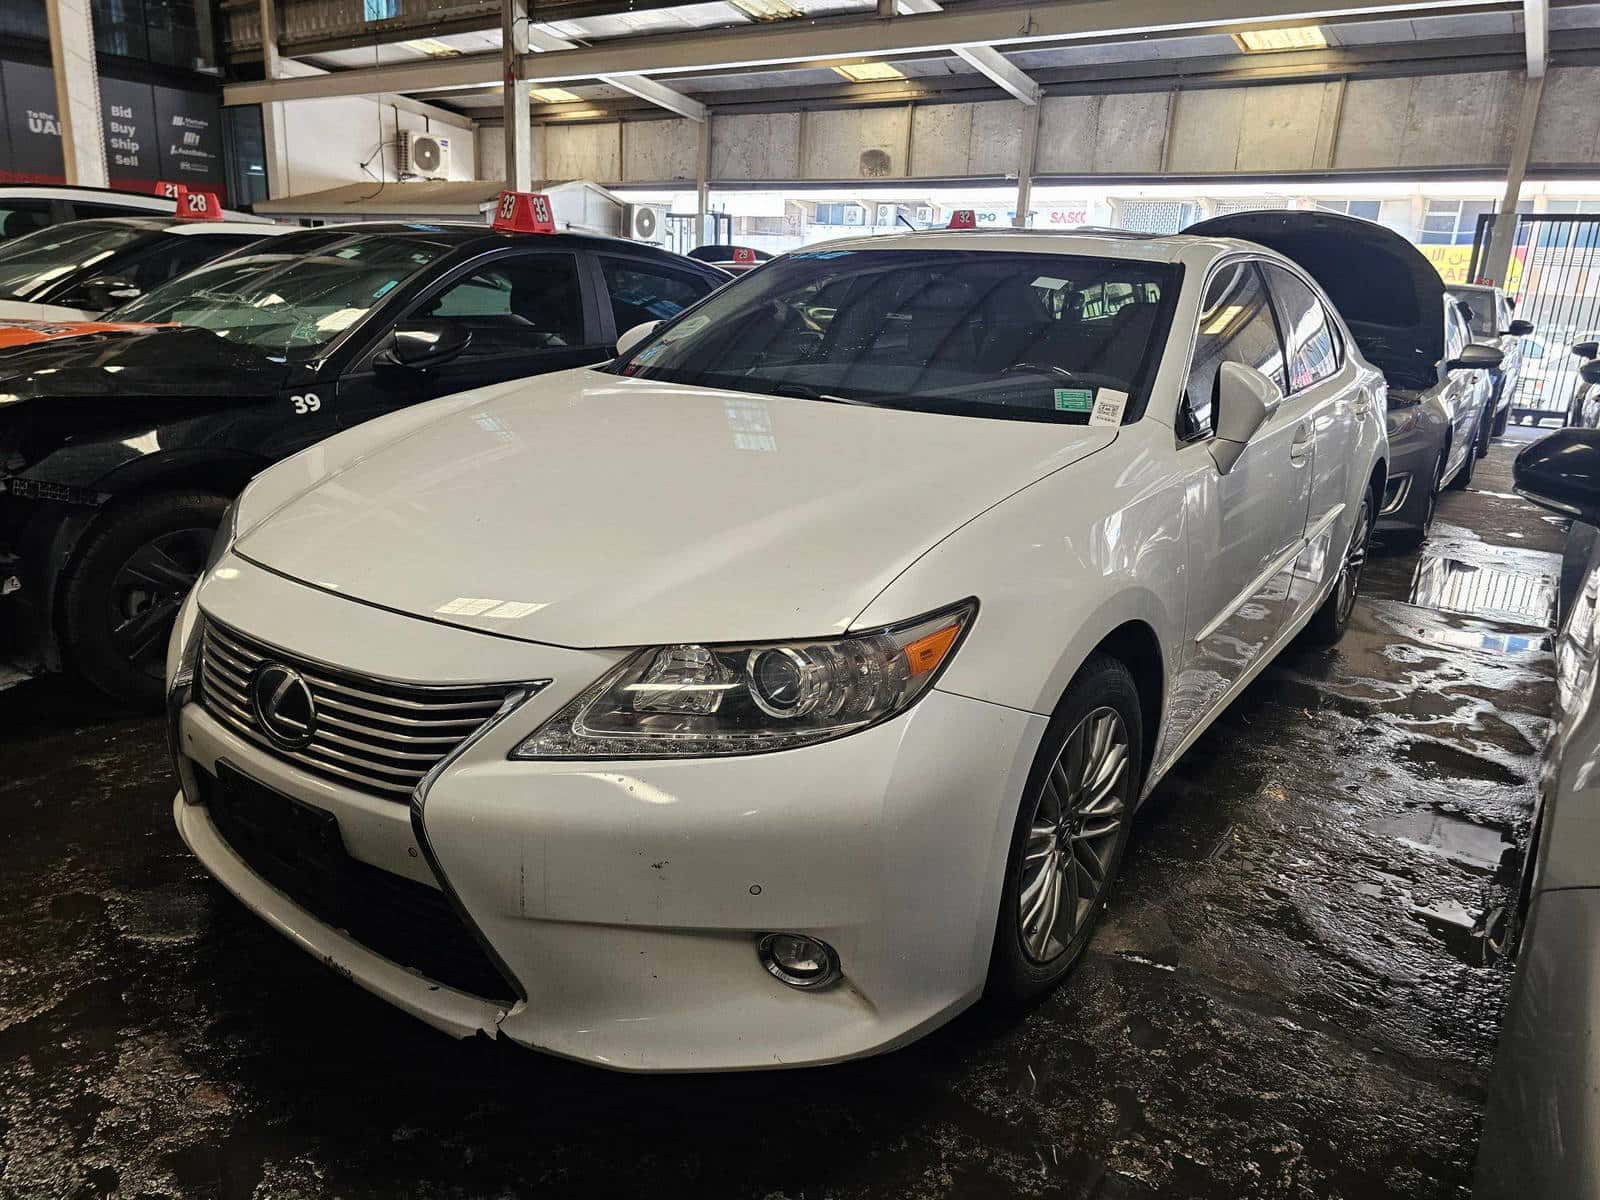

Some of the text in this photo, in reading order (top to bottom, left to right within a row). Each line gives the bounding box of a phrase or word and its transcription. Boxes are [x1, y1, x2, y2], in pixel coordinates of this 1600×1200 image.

[25, 110, 38, 119] To
[111, 105, 132, 118] Bid
[111, 121, 136, 138] Buy
[111, 138, 140, 154] Ship
[115, 154, 138, 167] Sell
[165, 183, 178, 198] 21
[188, 194, 207, 212] 28
[500, 194, 516, 219] 33
[533, 197, 549, 222] 33
[959, 211, 970, 223] 32
[290, 393, 321, 414] 39
